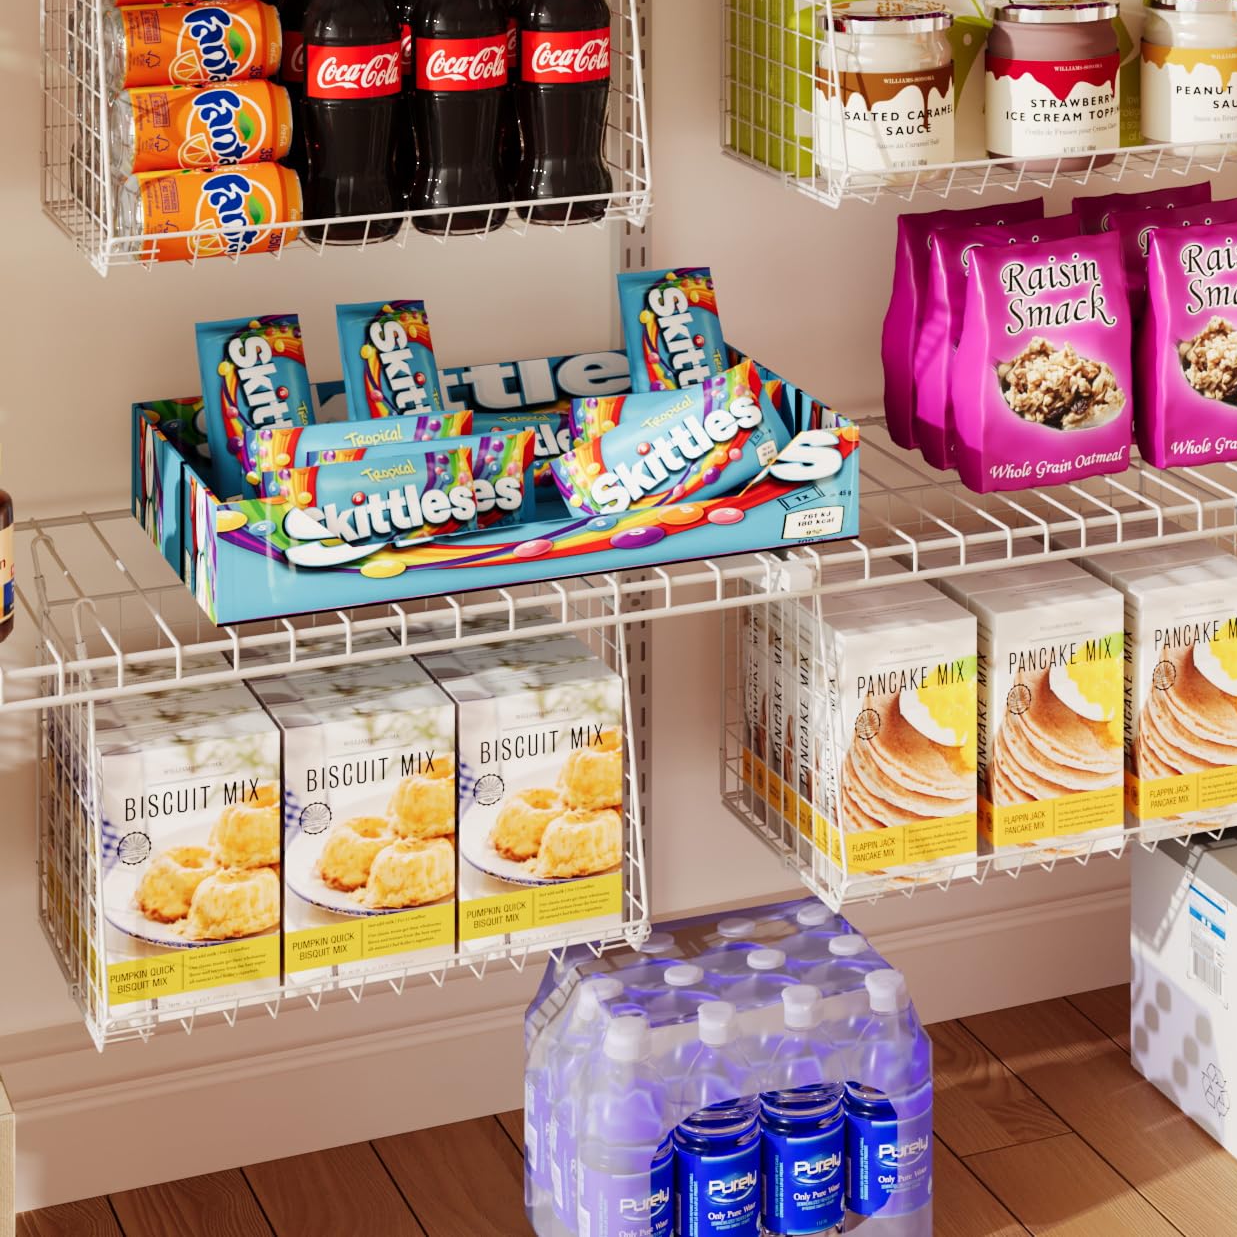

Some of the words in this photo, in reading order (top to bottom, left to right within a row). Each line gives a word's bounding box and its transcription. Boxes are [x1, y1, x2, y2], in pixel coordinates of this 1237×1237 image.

[317, 51, 398, 89] Coca-Cola
[425, 46, 506, 81] Coca-Cola
[531, 36, 610, 74] Coca-Cola
[1030, 94, 1115, 108] STRAWBERRY
[1176, 85, 1233, 96] PEANUT
[844, 110, 906, 122] SALTED
[886, 123, 932, 136] SAUCE
[1006, 111, 1025, 121] ICE
[1033, 111, 1082, 122] CREAM
[203, 173, 256, 252] Fanta
[1002, 253, 1099, 296] Raisin
[1007, 284, 1117, 335] Smack
[591, 396, 763, 516] Skittles
[1170, 439, 1212, 456] Whole
[1154, 620, 1220, 651] PANCAKE
[1009, 642, 1076, 674] PANCAKE
[1085, 637, 1112, 662] MIX
[857, 666, 928, 699] PANCAKE
[937, 660, 964, 686] MIX
[480, 730, 559, 764] BISCUIT
[571, 722, 604, 748] MIX
[306, 757, 388, 793] BISCUIT
[401, 749, 435, 778] MIX
[124, 785, 210, 822] BISCUIT
[224, 777, 259, 806] MIX
[852, 840, 875, 852] FLAPPIN
[877, 837, 896, 849] JACK
[466, 906, 501, 919] PUMPKIN
[502, 901, 527, 914] QUICK
[473, 915, 504, 929] BISQUIT
[505, 912, 520, 923] MIX
[794, 1151, 842, 1177] Purely
[708, 1170, 757, 1197] Purely
[793, 1191, 810, 1202] Only
[811, 1188, 825, 1199] Pure
